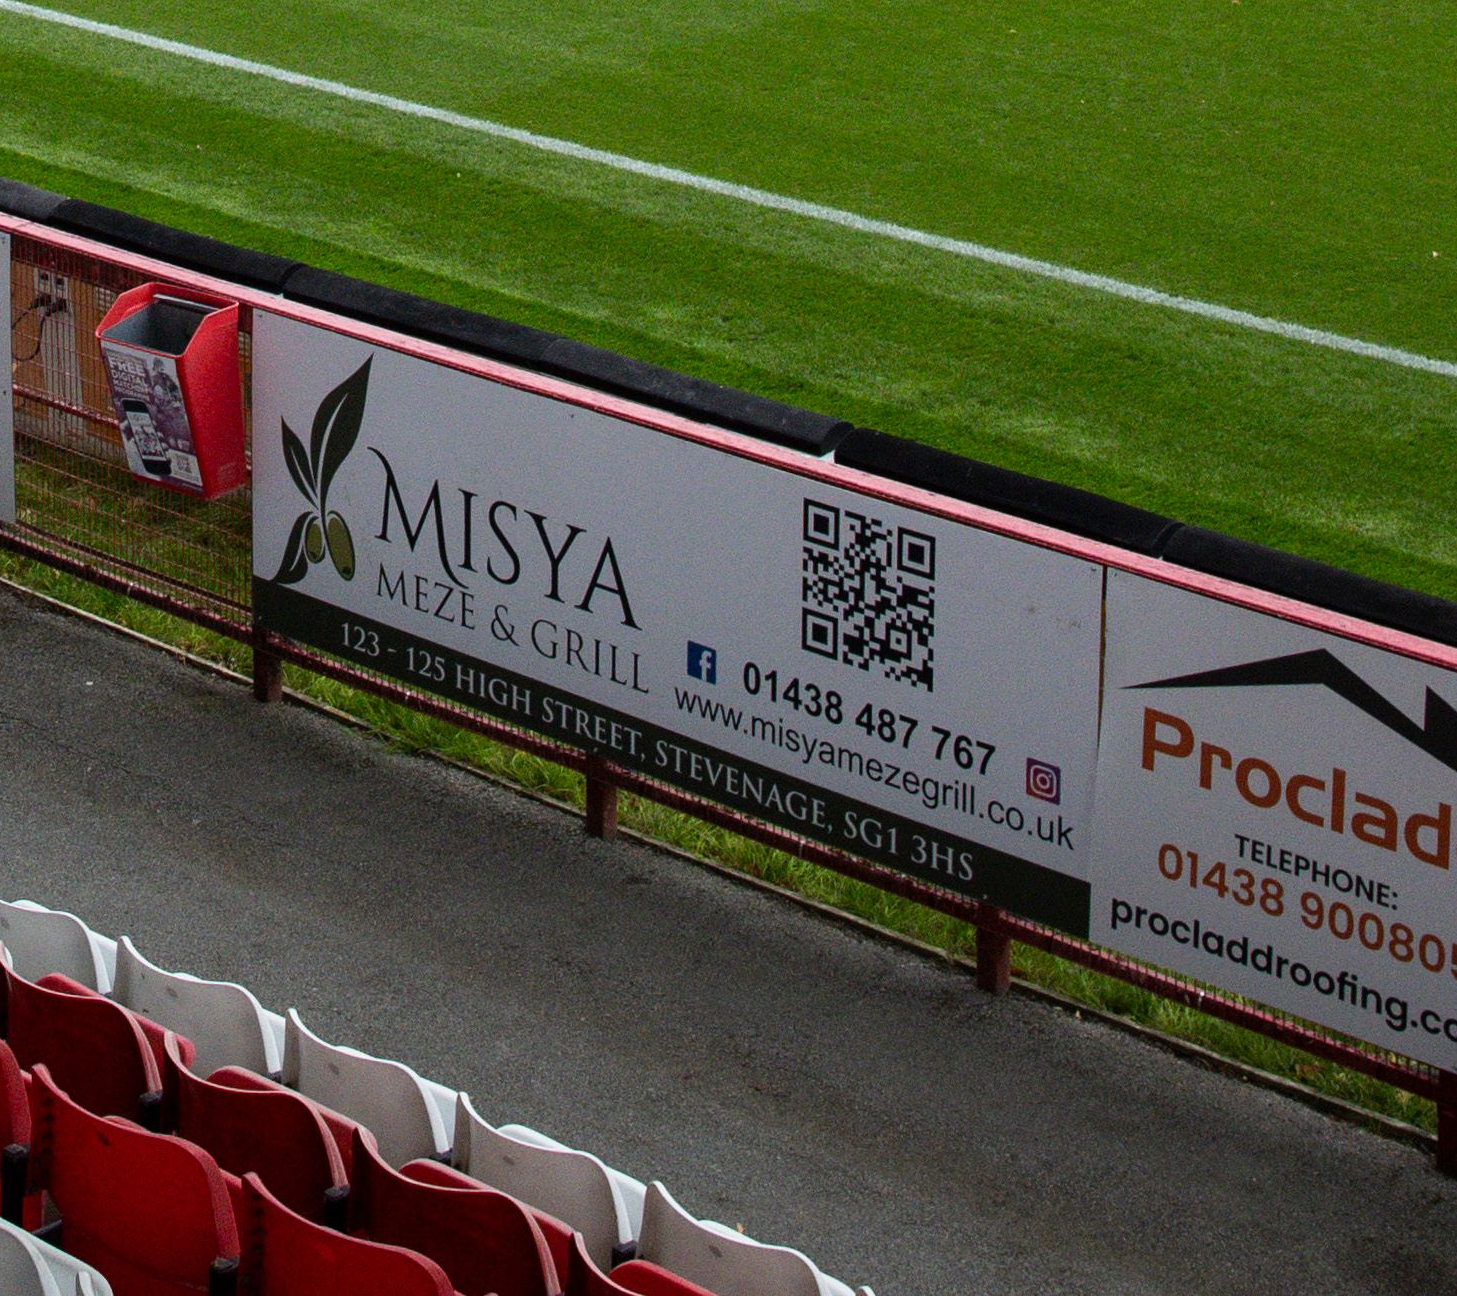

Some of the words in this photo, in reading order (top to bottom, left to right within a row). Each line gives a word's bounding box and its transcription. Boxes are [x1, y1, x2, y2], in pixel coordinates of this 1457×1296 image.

[368, 446, 644, 631] MISYA
[375, 561, 477, 632] MEZE
[490, 604, 520, 646] &
[530, 618, 651, 696] GRILL
[339, 621, 382, 656] 123
[406, 647, 447, 683] 125
[454, 664, 531, 717] HIGH
[540, 693, 648, 766] STREET,
[654, 737, 835, 837] STEVENAGE,
[842, 808, 900, 860] SG1
[909, 831, 975, 883] 3HS
[673, 685, 1077, 852] www.misyamezegrill.co.uk
[742, 660, 844, 728] 01438
[855, 697, 920, 752] 487
[932, 722, 997, 779] 767
[1157, 842, 1285, 917] 01438
[1234, 833, 1399, 910] TELEPHONE:
